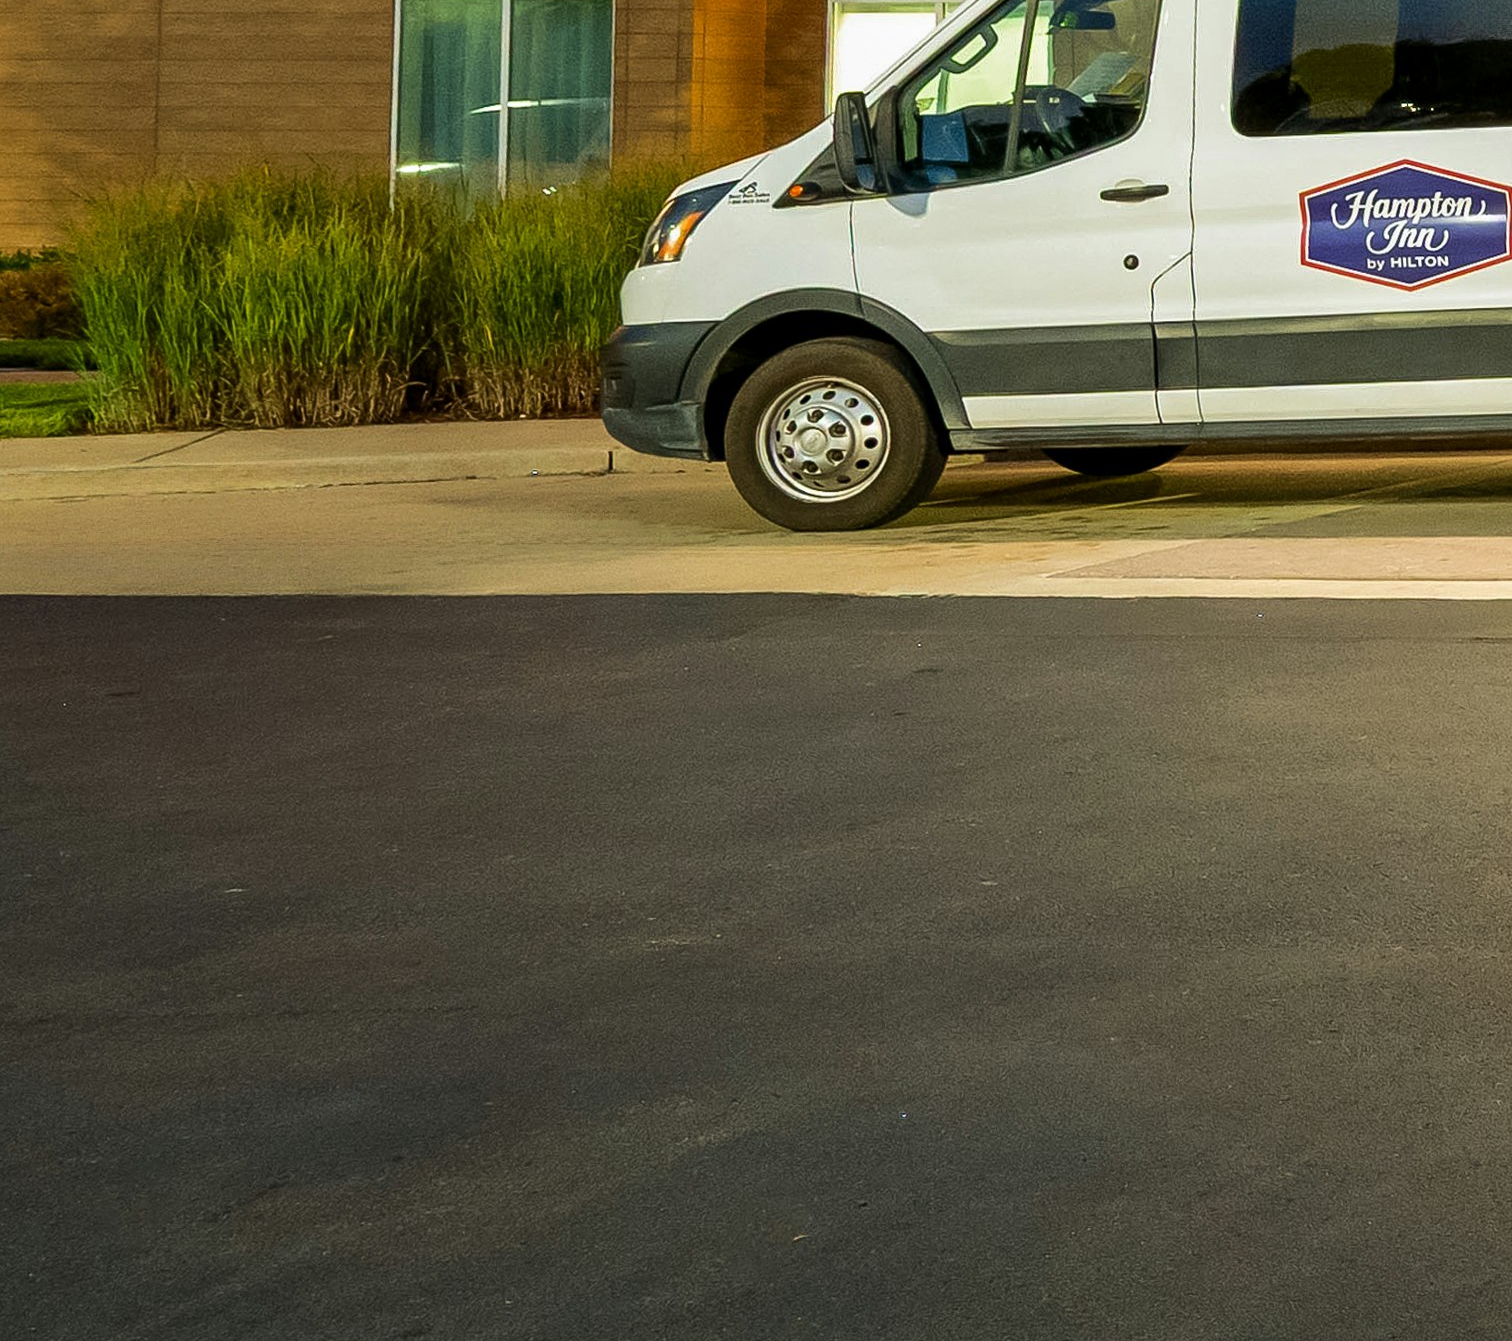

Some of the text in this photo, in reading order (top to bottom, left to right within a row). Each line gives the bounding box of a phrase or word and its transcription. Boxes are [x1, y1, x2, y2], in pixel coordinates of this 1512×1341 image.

[1330, 188, 1487, 230] Hampton
[1366, 219, 1450, 255] Inn
[1366, 255, 1449, 271] by HILTON
